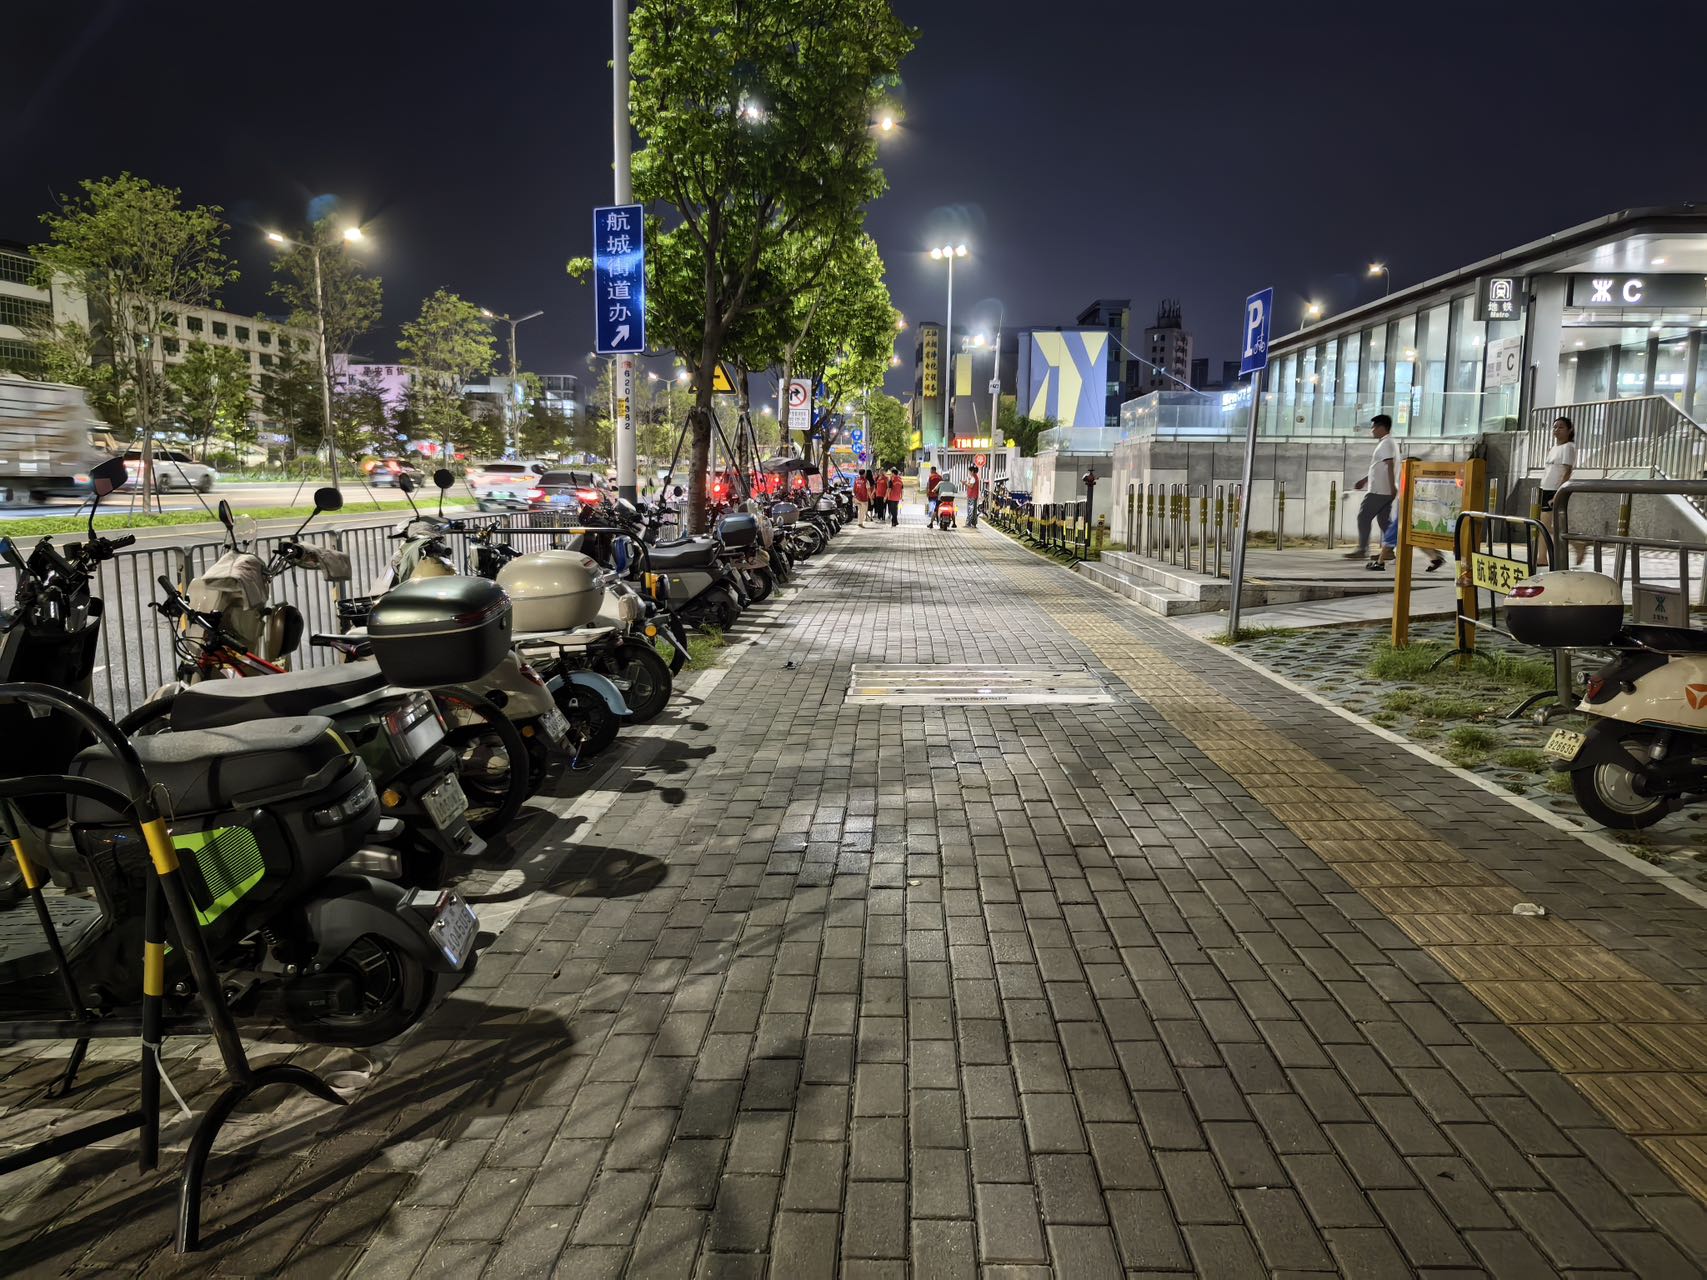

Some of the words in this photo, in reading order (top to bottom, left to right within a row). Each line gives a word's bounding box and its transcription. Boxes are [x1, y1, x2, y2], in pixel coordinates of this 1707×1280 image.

[606, 211, 632, 322] 航城街道办
[1622, 280, 1643, 303] C
[1488, 302, 1512, 312] 地铁
[1490, 311, 1510, 319] Metro
[1244, 299, 1264, 359] P
[1507, 353, 1515, 371] C
[624, 369, 632, 430] 6204382
[1476, 557, 1524, 589] 航城交安
